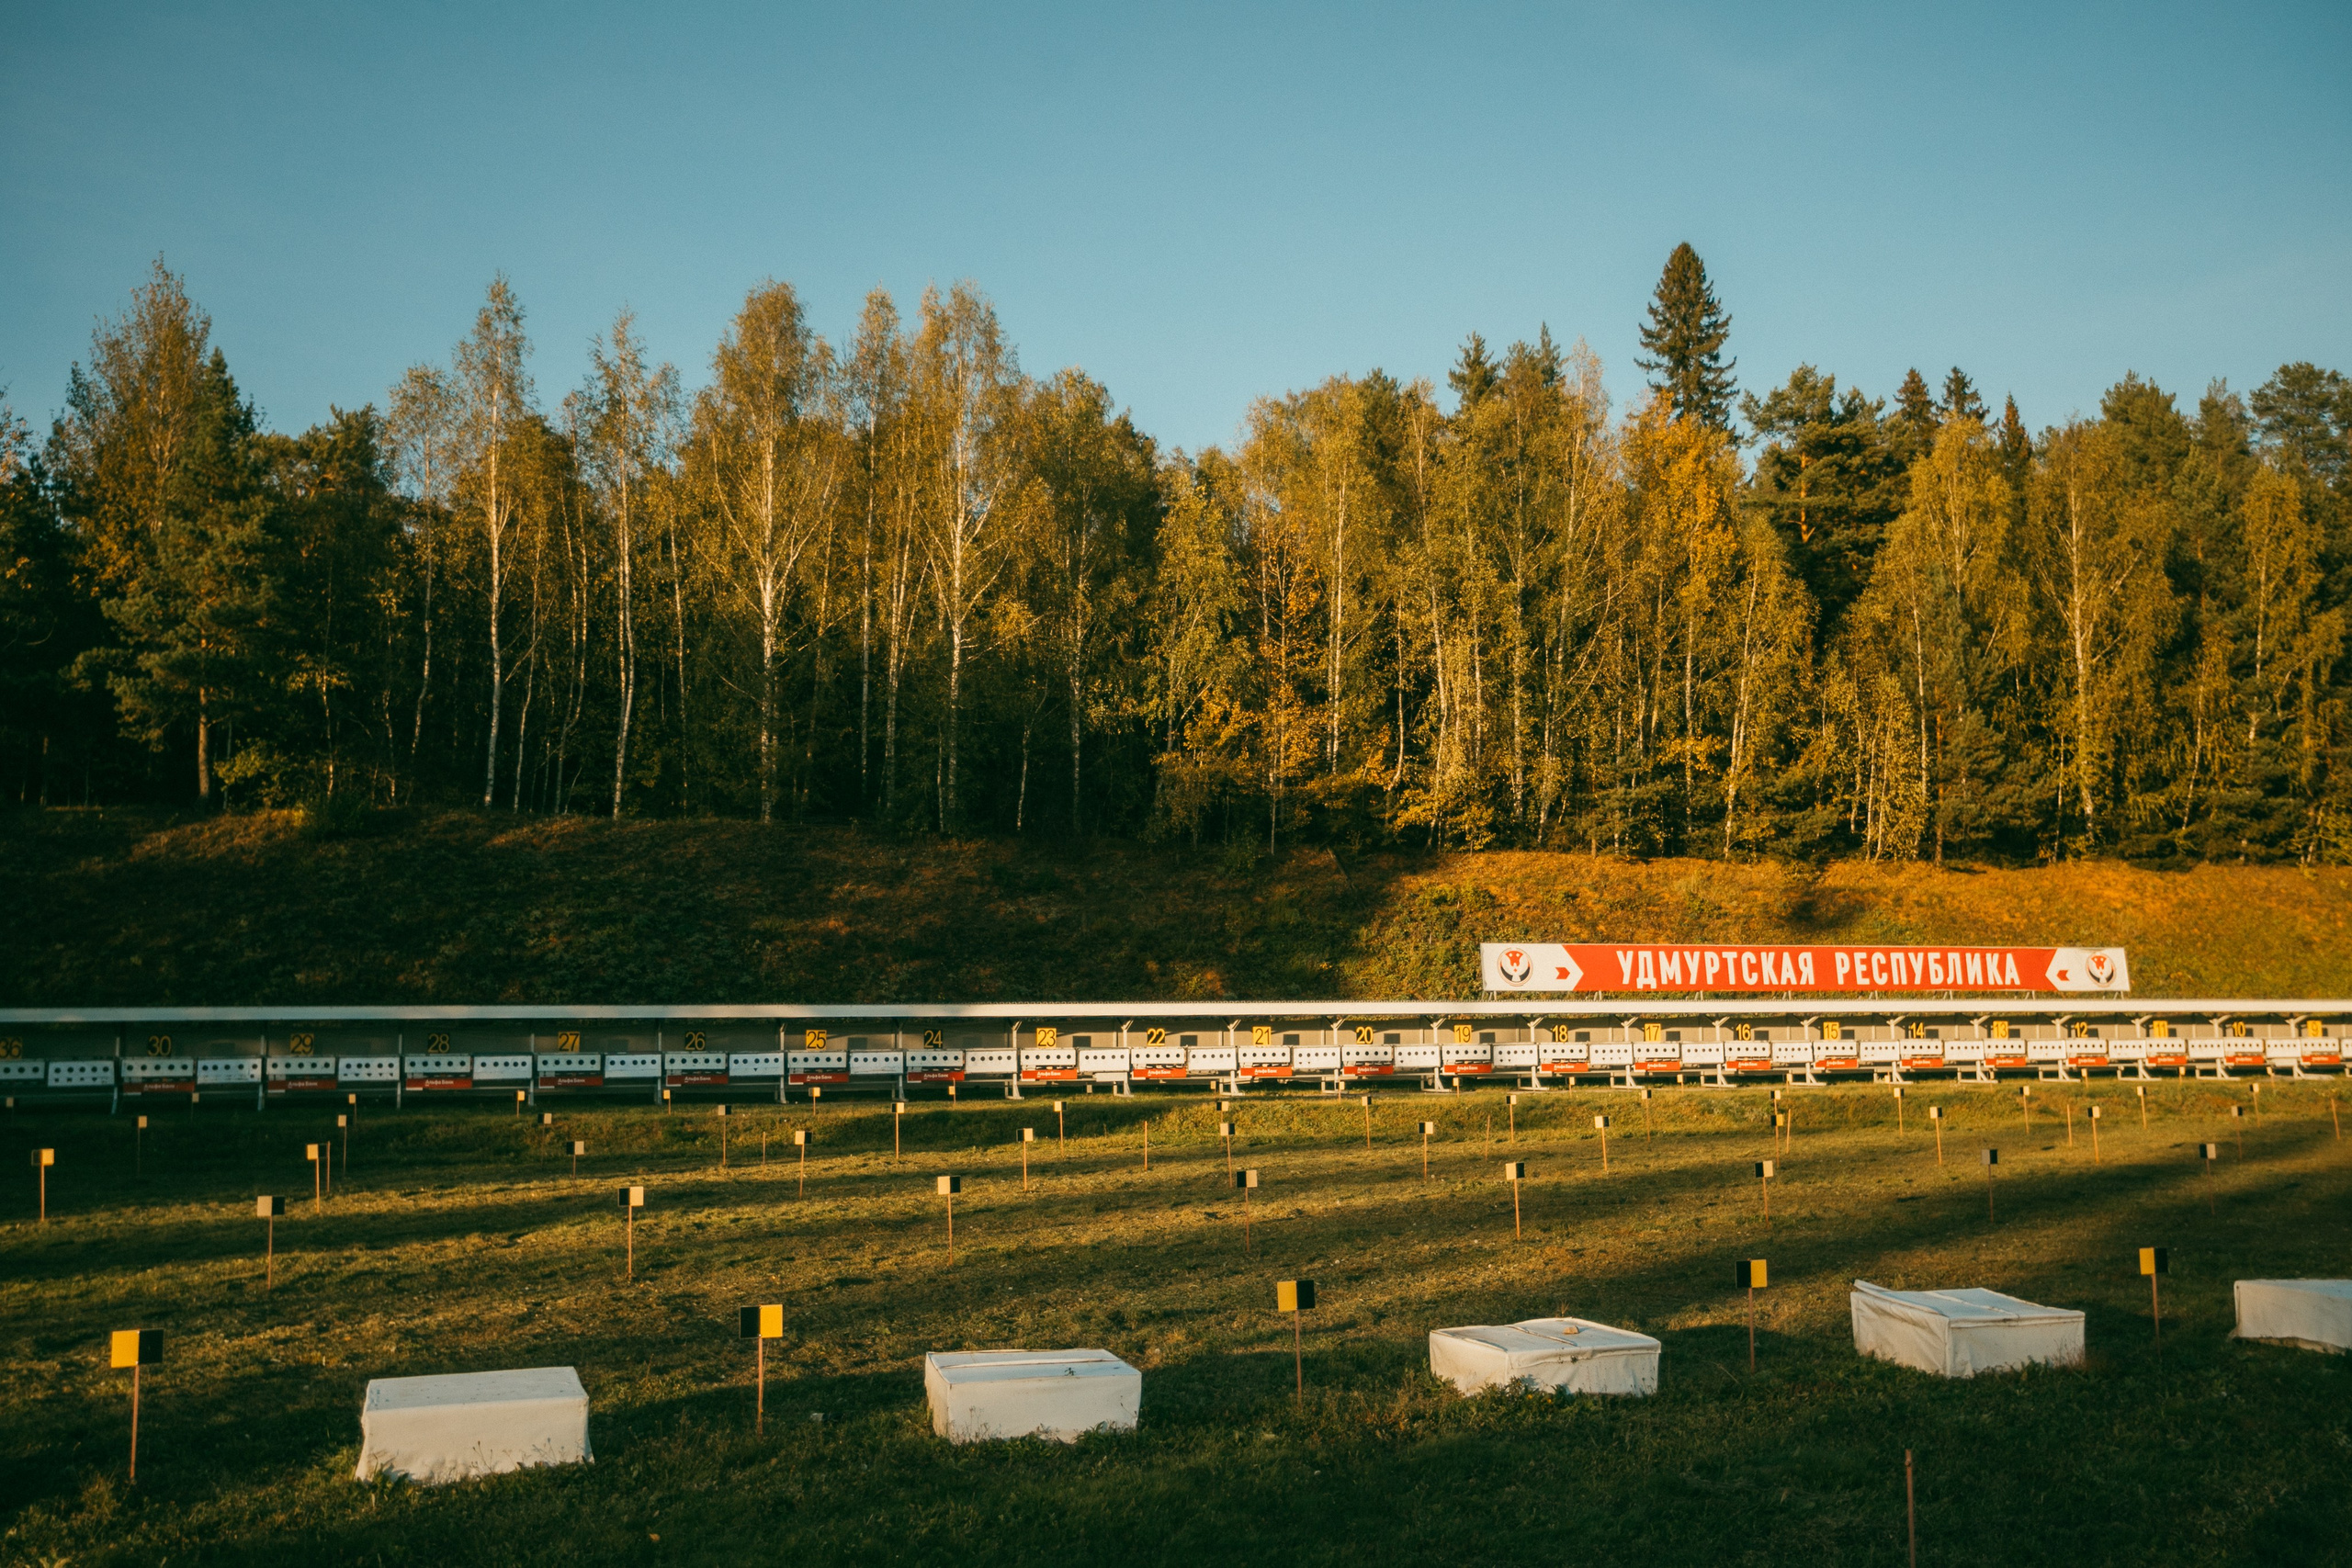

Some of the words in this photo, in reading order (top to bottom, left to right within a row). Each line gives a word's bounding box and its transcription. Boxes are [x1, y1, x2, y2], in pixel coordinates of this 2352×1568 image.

[1616, 951, 1815, 989] УДМУРТСКАЯ
[1834, 952, 2020, 986] РЕСПУБЛИКА
[1147, 1028, 1166, 1046] 22
[1255, 1028, 1270, 1045] 21
[1355, 1026, 1374, 1044] 20
[1455, 1026, 1471, 1043] 19
[1552, 1024, 1568, 1043] 18
[1645, 1025, 1660, 1042] 17
[1736, 1023, 1751, 1041] 16
[1825, 1023, 1838, 1040] 15
[1910, 1021, 1925, 1039] 14
[1995, 1022, 2007, 1038] 13
[2074, 1021, 2088, 1038] 12
[2156, 1022, 2166, 1037] 11
[2232, 1021, 2246, 1037] 10
[2311, 1021, 2320, 1036] 9
[148, 1035, 171, 1056] 30
[291, 1034, 313, 1054] 29
[427, 1033, 449, 1053] 28
[560, 1032, 579, 1052] 27
[684, 1032, 706, 1051] 26
[807, 1031, 826, 1049] 25
[924, 1030, 943, 1048] 24
[1037, 1029, 1056, 1047] 23
